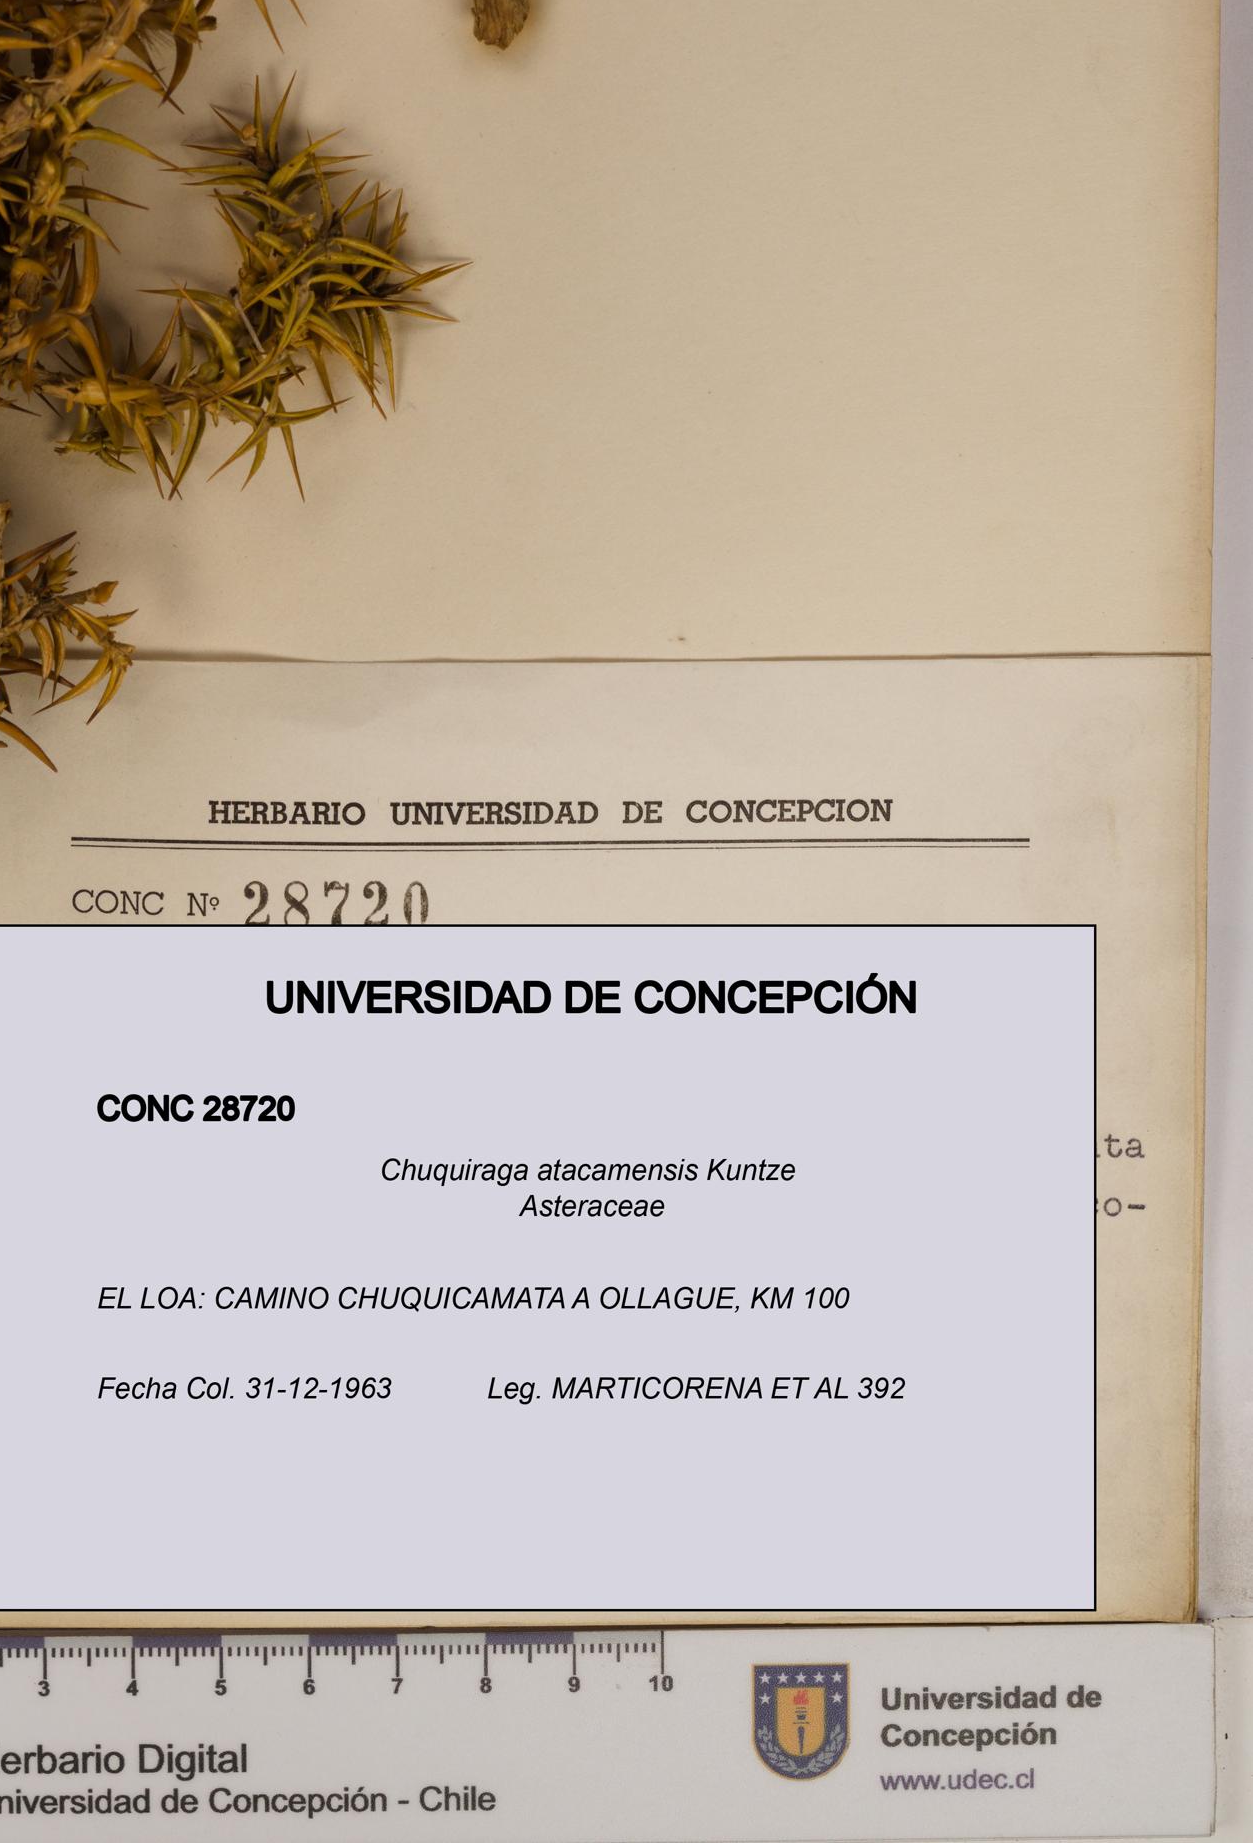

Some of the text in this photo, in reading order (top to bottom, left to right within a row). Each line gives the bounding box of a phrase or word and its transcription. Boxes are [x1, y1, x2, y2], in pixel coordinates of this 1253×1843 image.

[208, 799, 894, 827] HERBARIO UNIVERSIDAD DE CONCEPCION
[71, 889, 165, 917] CONC
[243, 881, 429, 925] 28720
[1095, 1132, 1146, 1160] ta
[37, 1680, 51, 1699] 3
[125, 1679, 140, 1698] 4
[214, 1679, 228, 1698] 5
[302, 1678, 316, 1697] 6
[391, 1677, 404, 1696] 7
[479, 1676, 493, 1695] 8
[567, 1675, 581, 1694] 9
[648, 1674, 674, 1693] 10
[881, 1685, 1102, 1712] Universidad de
[880, 1722, 1057, 1753] Concepción
[138, 1744, 248, 1784] Digital
[879, 1768, 1035, 1792] www.udec.cl
[160, 1787, 199, 1816] de
[208, 1787, 388, 1821] Concepción
[419, 1786, 497, 1813] Chile
